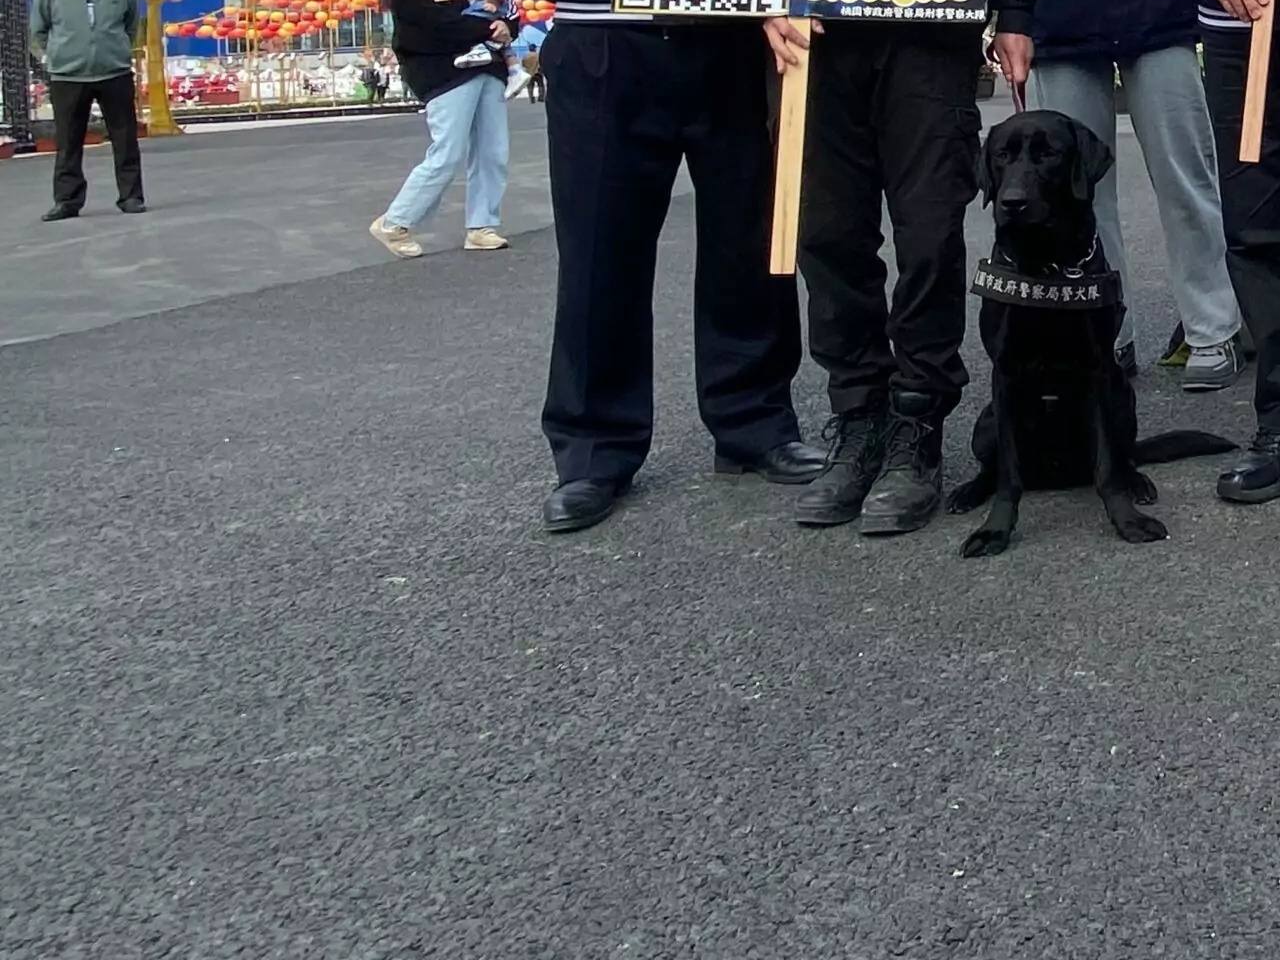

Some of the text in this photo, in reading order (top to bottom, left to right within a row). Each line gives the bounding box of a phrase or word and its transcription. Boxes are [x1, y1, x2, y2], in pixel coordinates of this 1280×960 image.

[840, 6, 986, 22] 桃園市政府警察局刑事警察大隊
